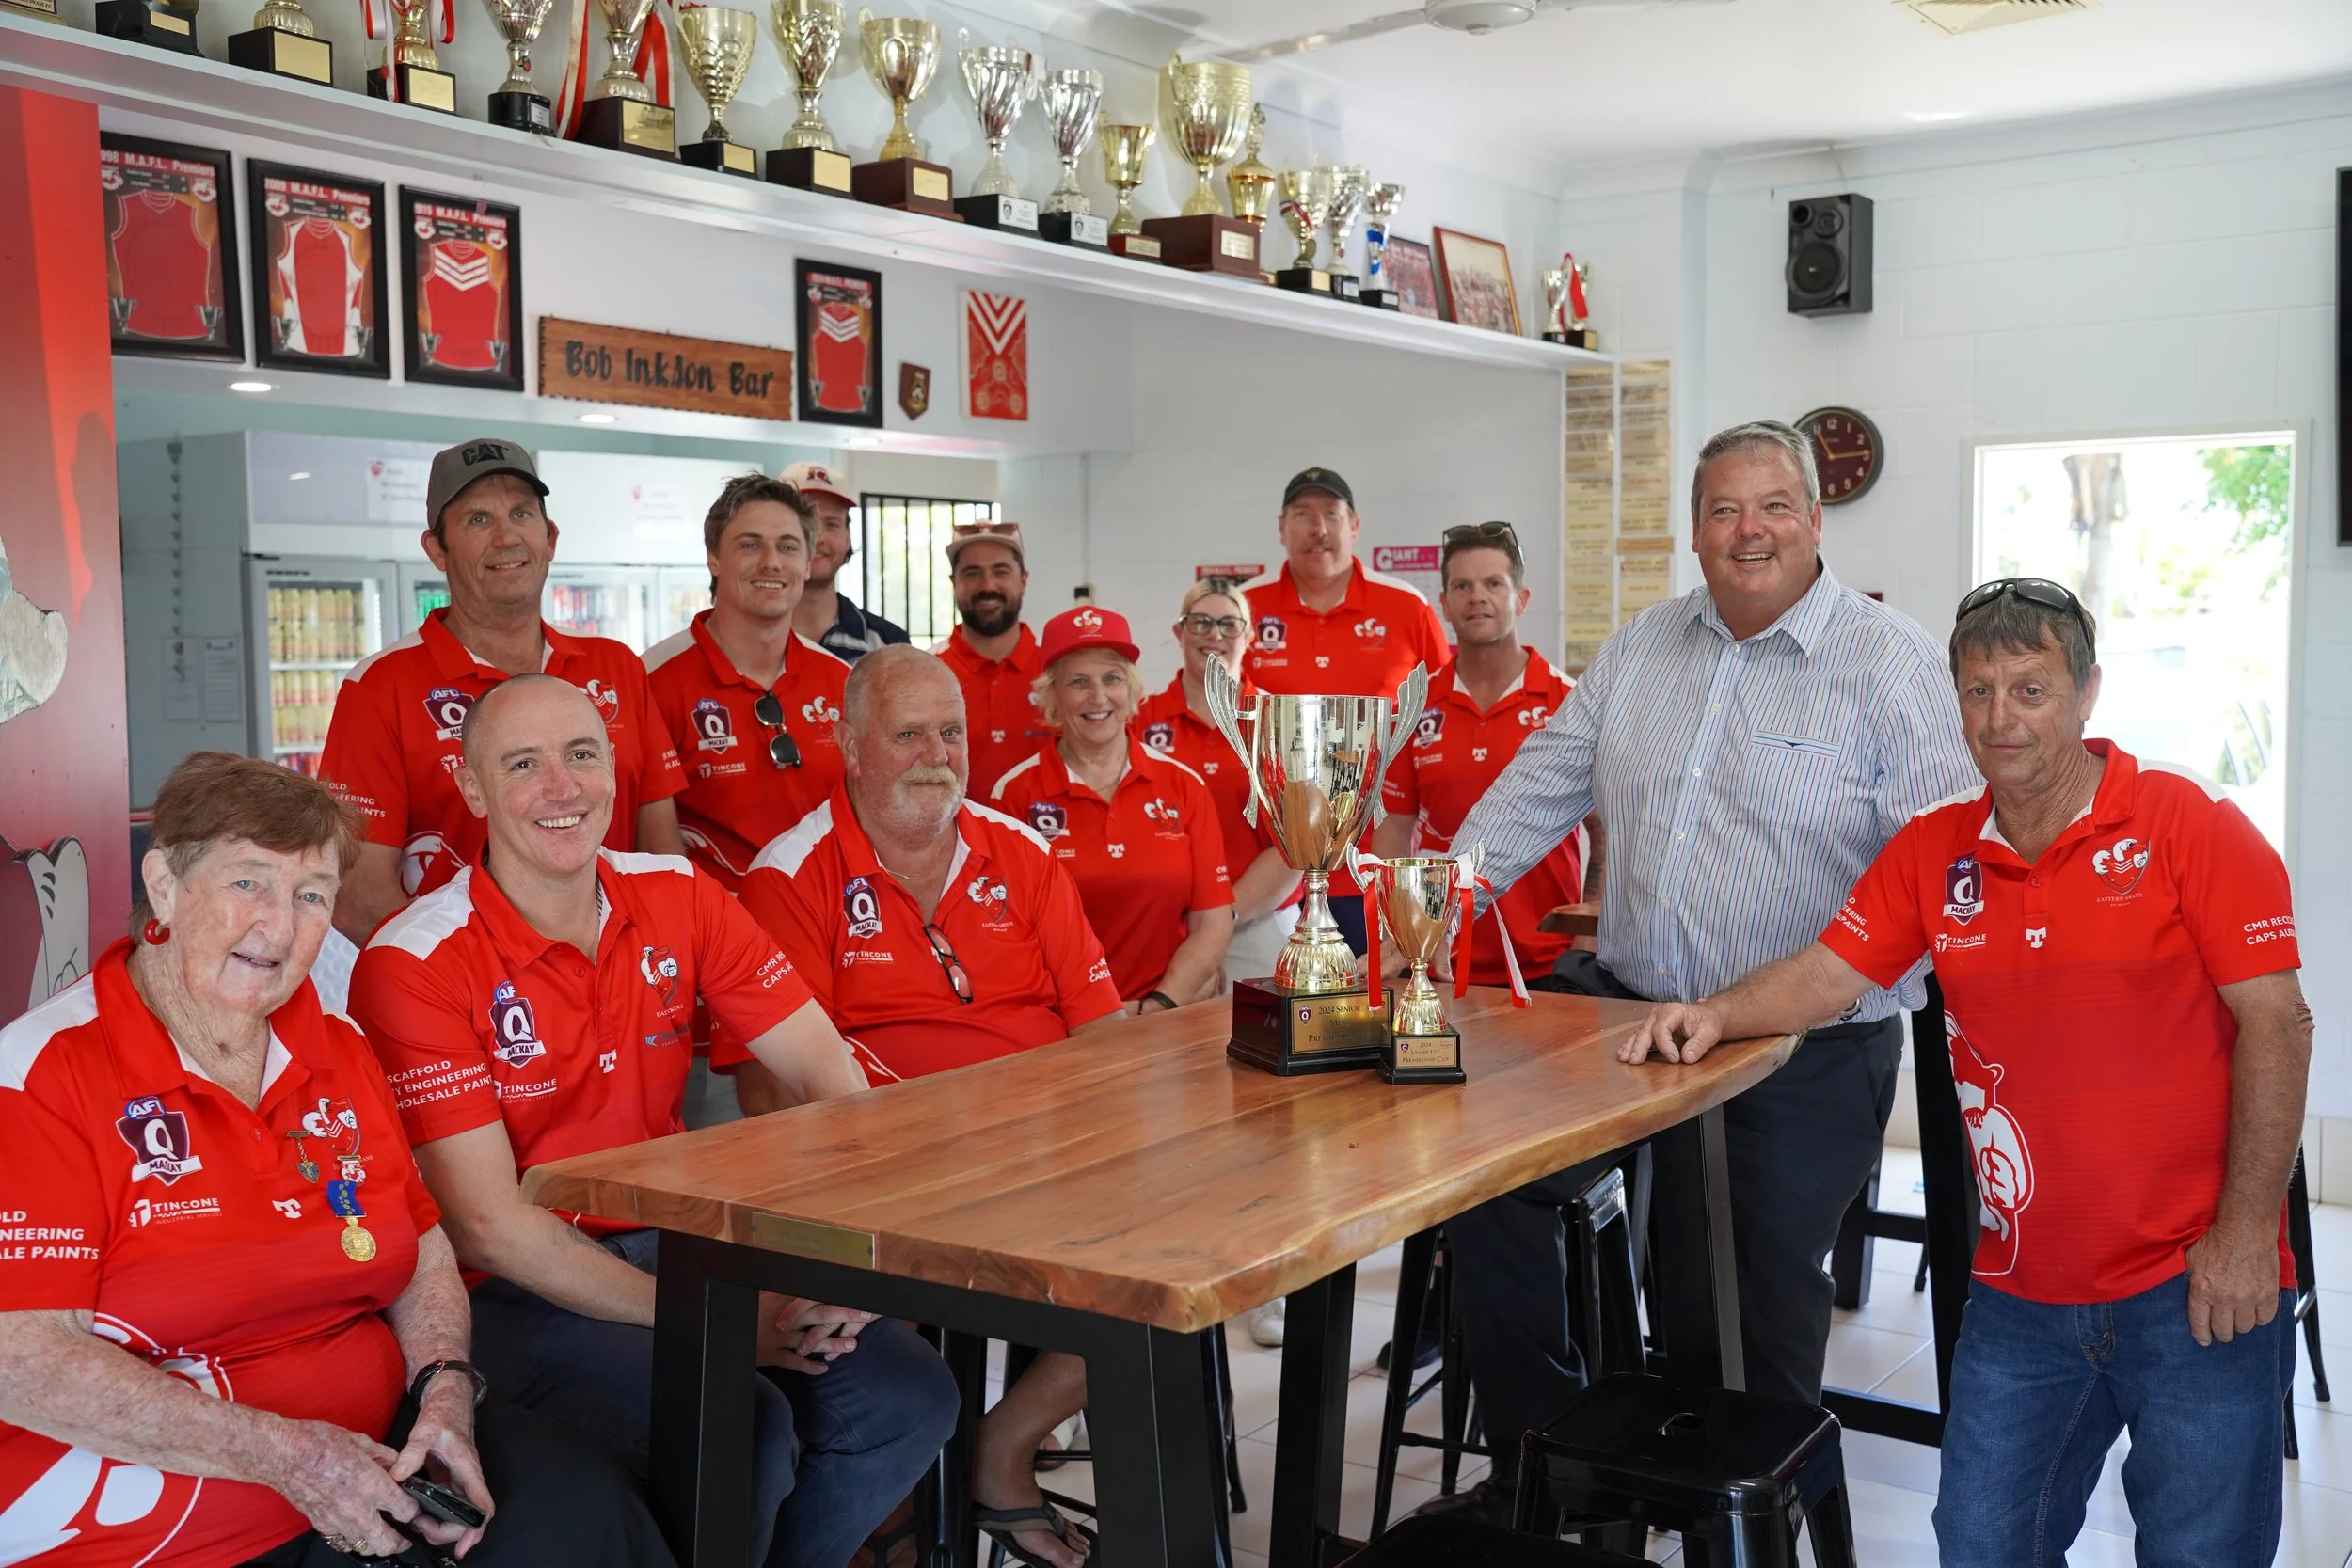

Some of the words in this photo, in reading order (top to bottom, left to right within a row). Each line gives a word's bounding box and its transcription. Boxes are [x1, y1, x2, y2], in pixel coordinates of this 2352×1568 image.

[100, 149, 119, 164] 998
[125, 151, 167, 170] M.A.F.L.
[172, 159, 216, 178] Premiers
[291, 181, 328, 199] M.A.F.L.
[565, 340, 612, 381] Bob
[625, 347, 717, 393] Inkson
[728, 361, 776, 399] Bar
[1827, 418, 1838, 430] 12
[1856, 433, 1865, 445] 2
[461, 444, 506, 467] CAT
[1856, 466, 1864, 478] 4
[1827, 483, 1836, 496] 6
[1844, 478, 1851, 490] 5
[1376, 548, 1420, 570] GIANT
[1263, 626, 1280, 642] Q
[433, 689, 460, 700] AFL
[699, 701, 719, 709] AFL
[705, 714, 726, 737] Q
[1037, 815, 1058, 830] Q
[1958, 859, 1974, 869] AF
[1953, 876, 1975, 904] Q
[852, 893, 877, 921] Q
[2244, 919, 2270, 932] CMR
[1947, 934, 1986, 944] TINCONE
[2246, 931, 2277, 945] CAPS
[756, 958, 779, 976] CMR
[763, 967, 788, 989] CAPS
[499, 985, 516, 1003] AF
[1318, 1006, 1335, 1015] 2024
[503, 1006, 534, 1043] Q
[387, 1060, 452, 1084] SCAFFOLD
[405, 1063, 486, 1093] ENGINEERING
[395, 1085, 461, 1110] HOLESALE
[463, 1074, 493, 1092] PAINT
[503, 1078, 557, 1094] TINCONE
[144, 1118, 180, 1160] Q
[151, 1197, 220, 1213] TINCONE
[31, 1246, 100, 1260] PAINTS
